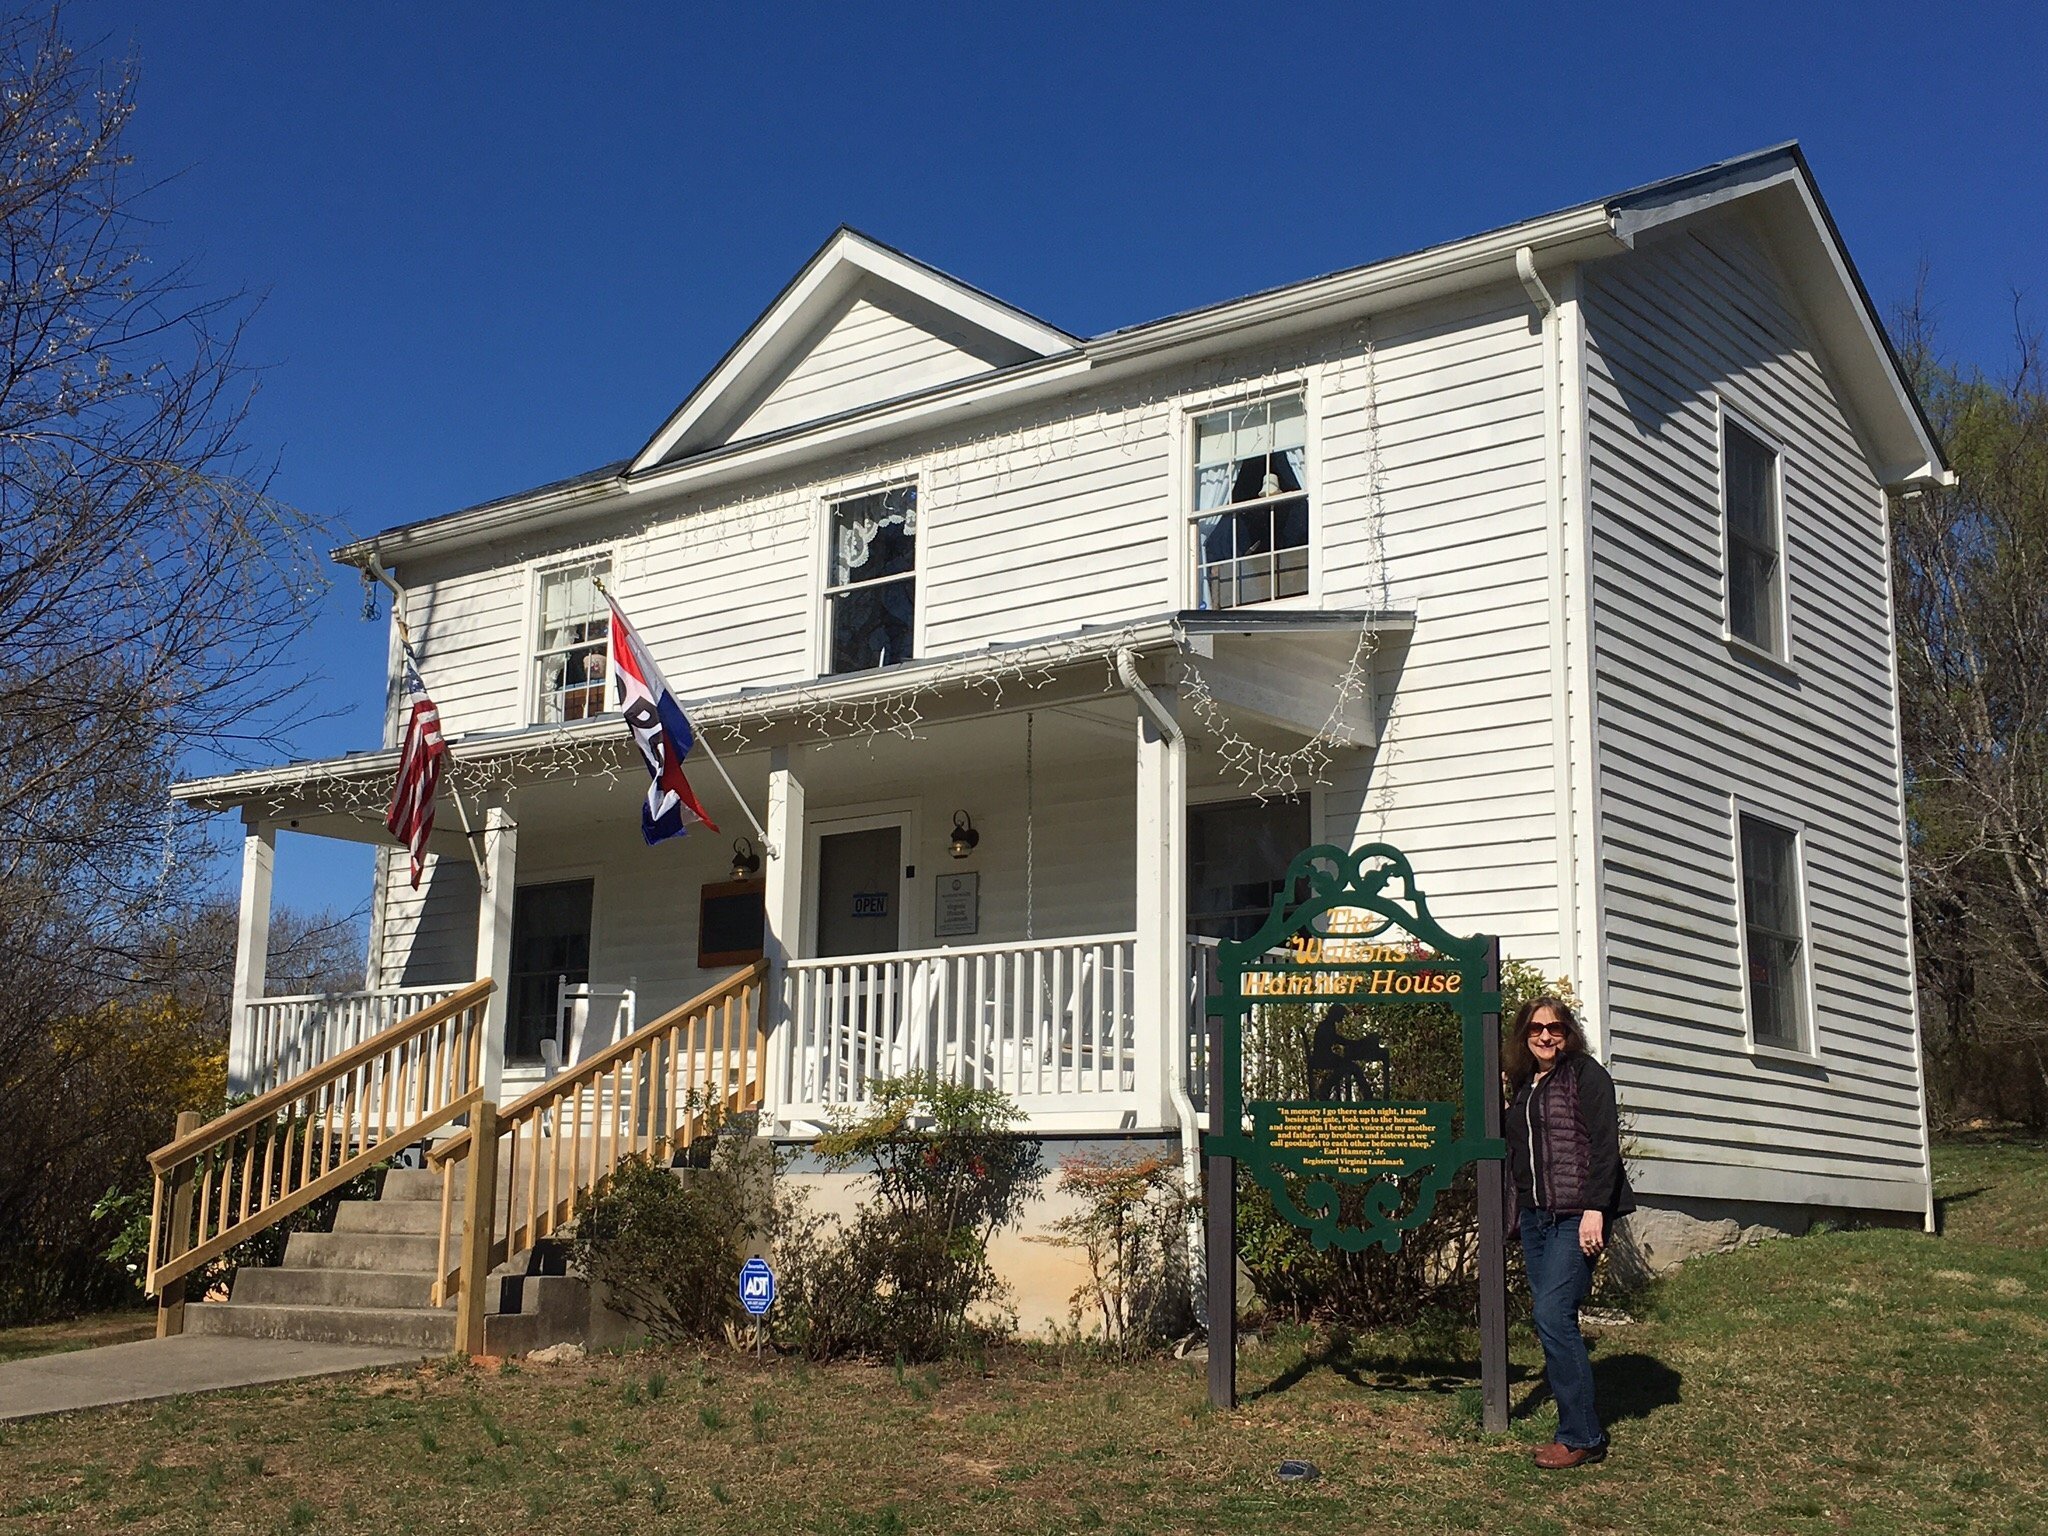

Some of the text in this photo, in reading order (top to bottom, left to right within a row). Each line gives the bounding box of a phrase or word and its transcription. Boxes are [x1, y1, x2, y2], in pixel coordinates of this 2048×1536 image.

[855, 897, 884, 913] OPEN
[1326, 908, 1375, 934] The
[1292, 935, 1407, 964] Waltons
[1244, 969, 1461, 996] Hamner House
[1377, 1108, 1399, 1116] night,
[1284, 1140, 1321, 1148] goodnight
[1341, 1148, 1374, 1156] Hamner,
[745, 1277, 768, 1296] ADT
